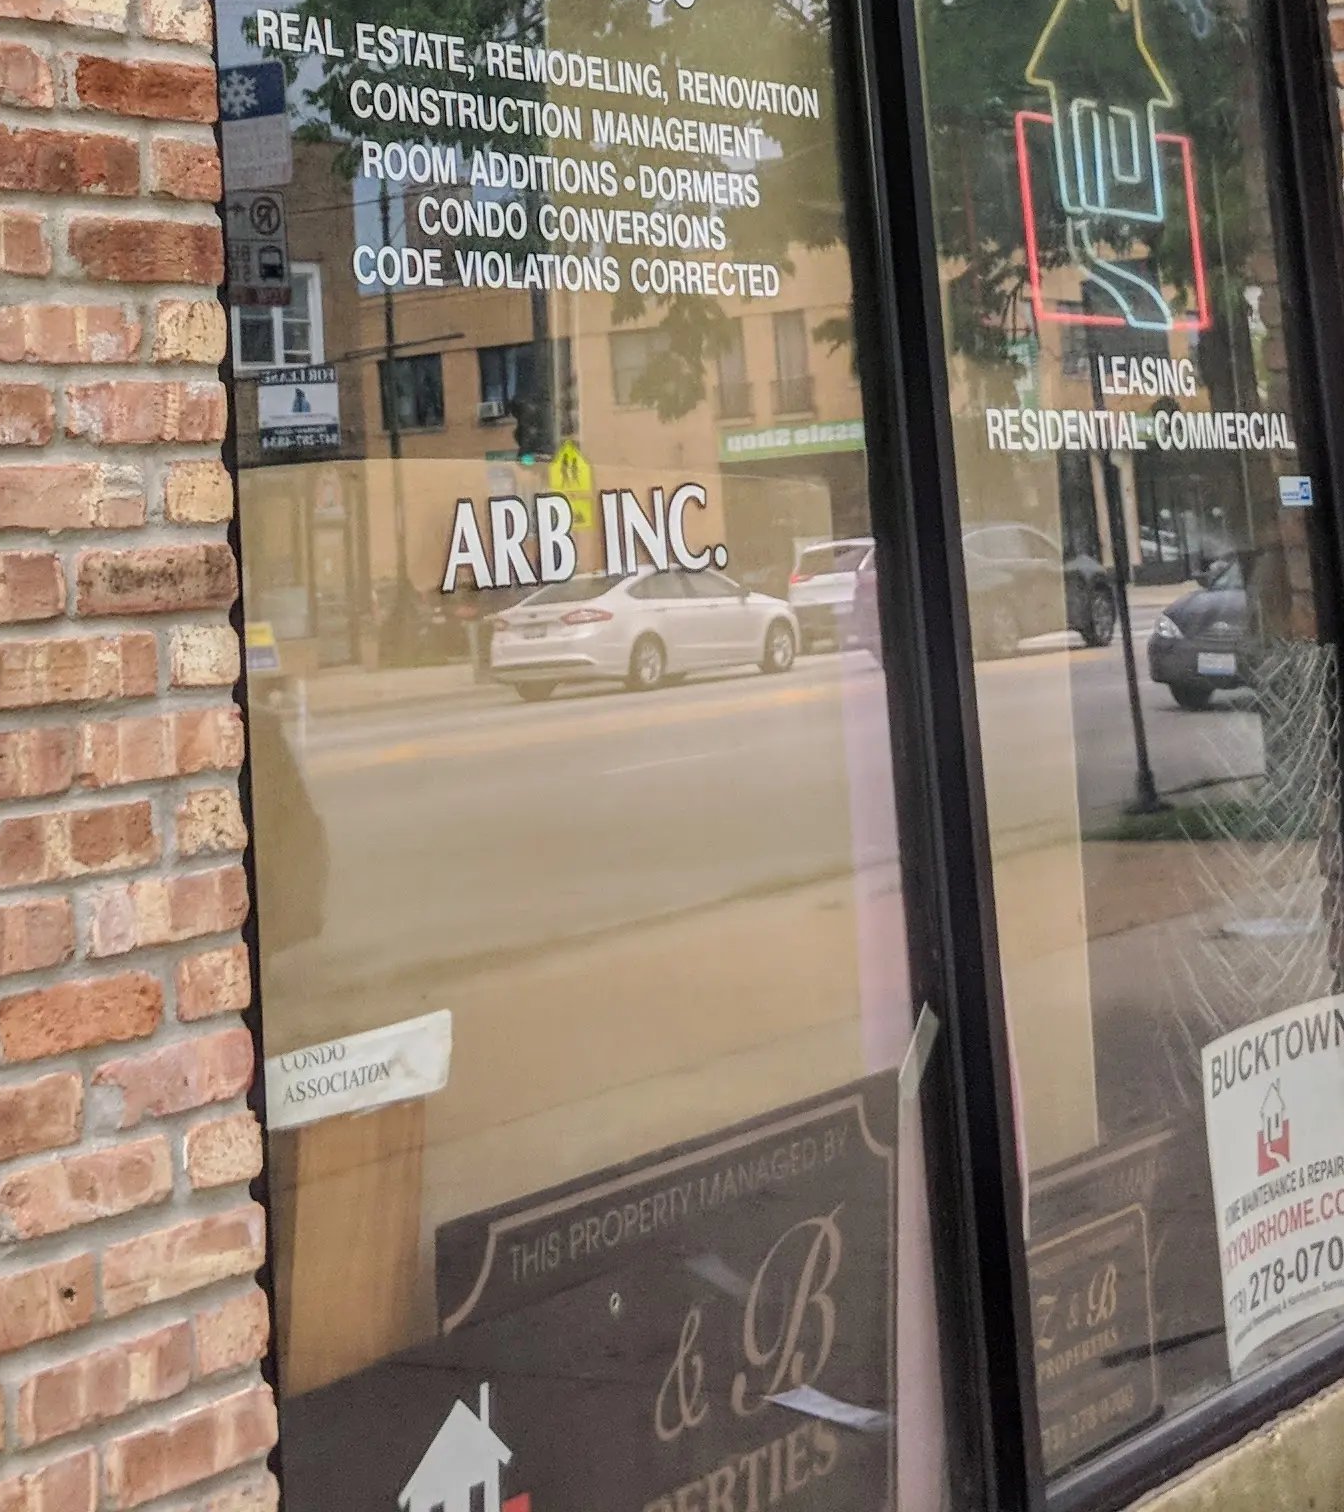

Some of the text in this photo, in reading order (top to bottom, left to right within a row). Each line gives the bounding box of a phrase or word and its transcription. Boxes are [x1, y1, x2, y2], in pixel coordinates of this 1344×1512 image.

[256, 9, 821, 120] REAL ESTATE, REMODELING, RENOVATION
[350, 80, 764, 162] CONSTRUCTION MANAGEMENT
[362, 140, 458, 186] ROOM
[418, 196, 728, 252] CONDO CONVERSIONS
[353, 245, 780, 299] CODE VIOLATIONS CORRECTED
[1098, 354, 1197, 397] LEASING
[985, 408, 1148, 453] RESIDENTIAL
[441, 482, 729, 593] ARB INC.
[280, 1041, 346, 1073] CONDO
[1299, 1167, 1305, 1188] &
[511, 1231, 560, 1283] THIS
[569, 1182, 692, 1260] PROPERTY
[700, 1136, 816, 1206] MANAGED
[731, 1201, 844, 1412] B
